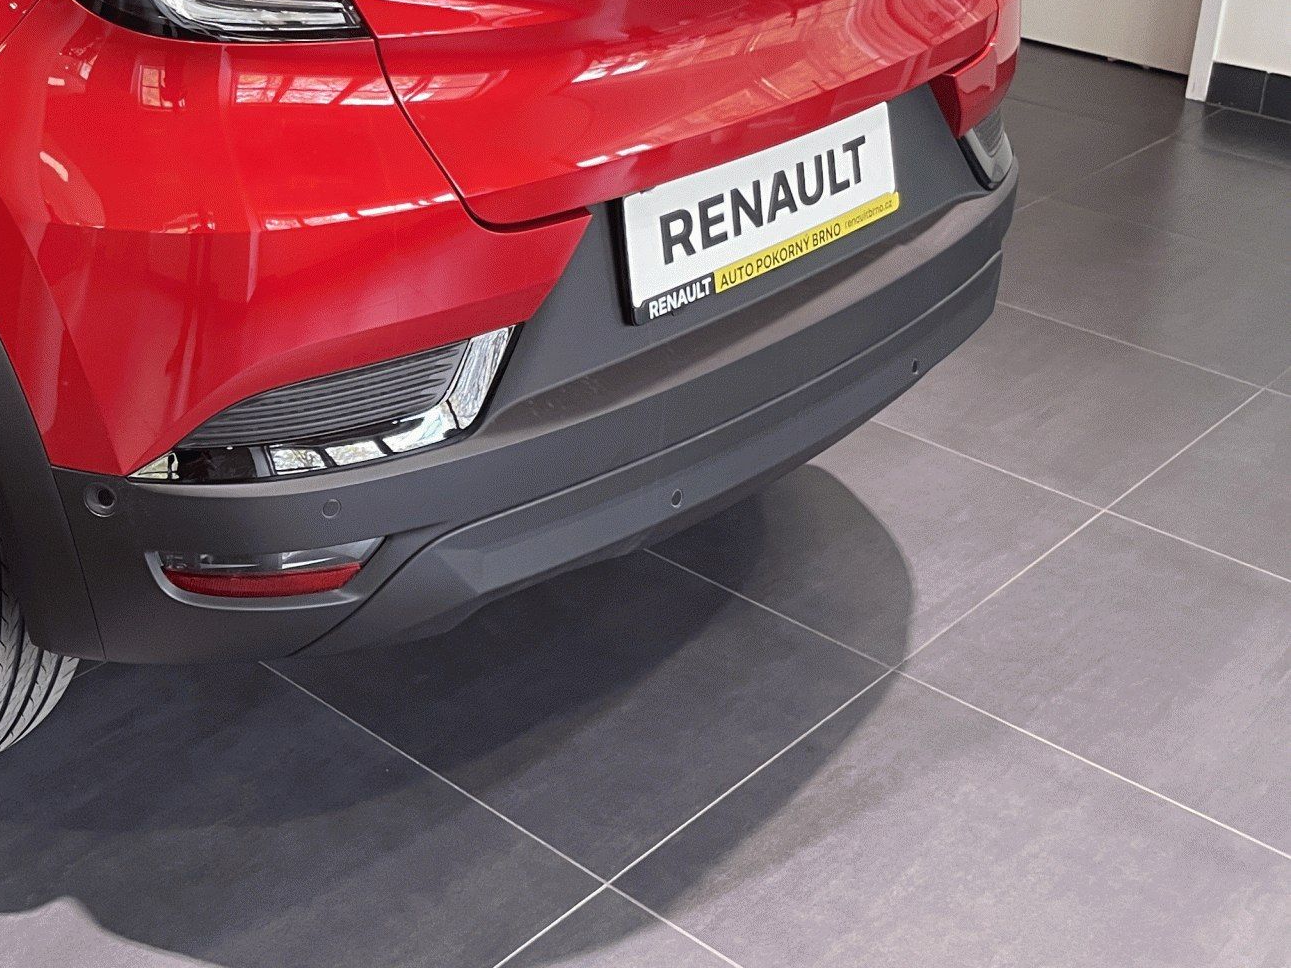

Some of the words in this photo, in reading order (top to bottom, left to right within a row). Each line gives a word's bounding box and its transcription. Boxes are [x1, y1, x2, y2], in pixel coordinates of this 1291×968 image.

[659, 135, 867, 265] RENAULT
[648, 277, 712, 319] RENAULT
[720, 263, 753, 288] AUTO
[812, 223, 841, 247] BRNO
